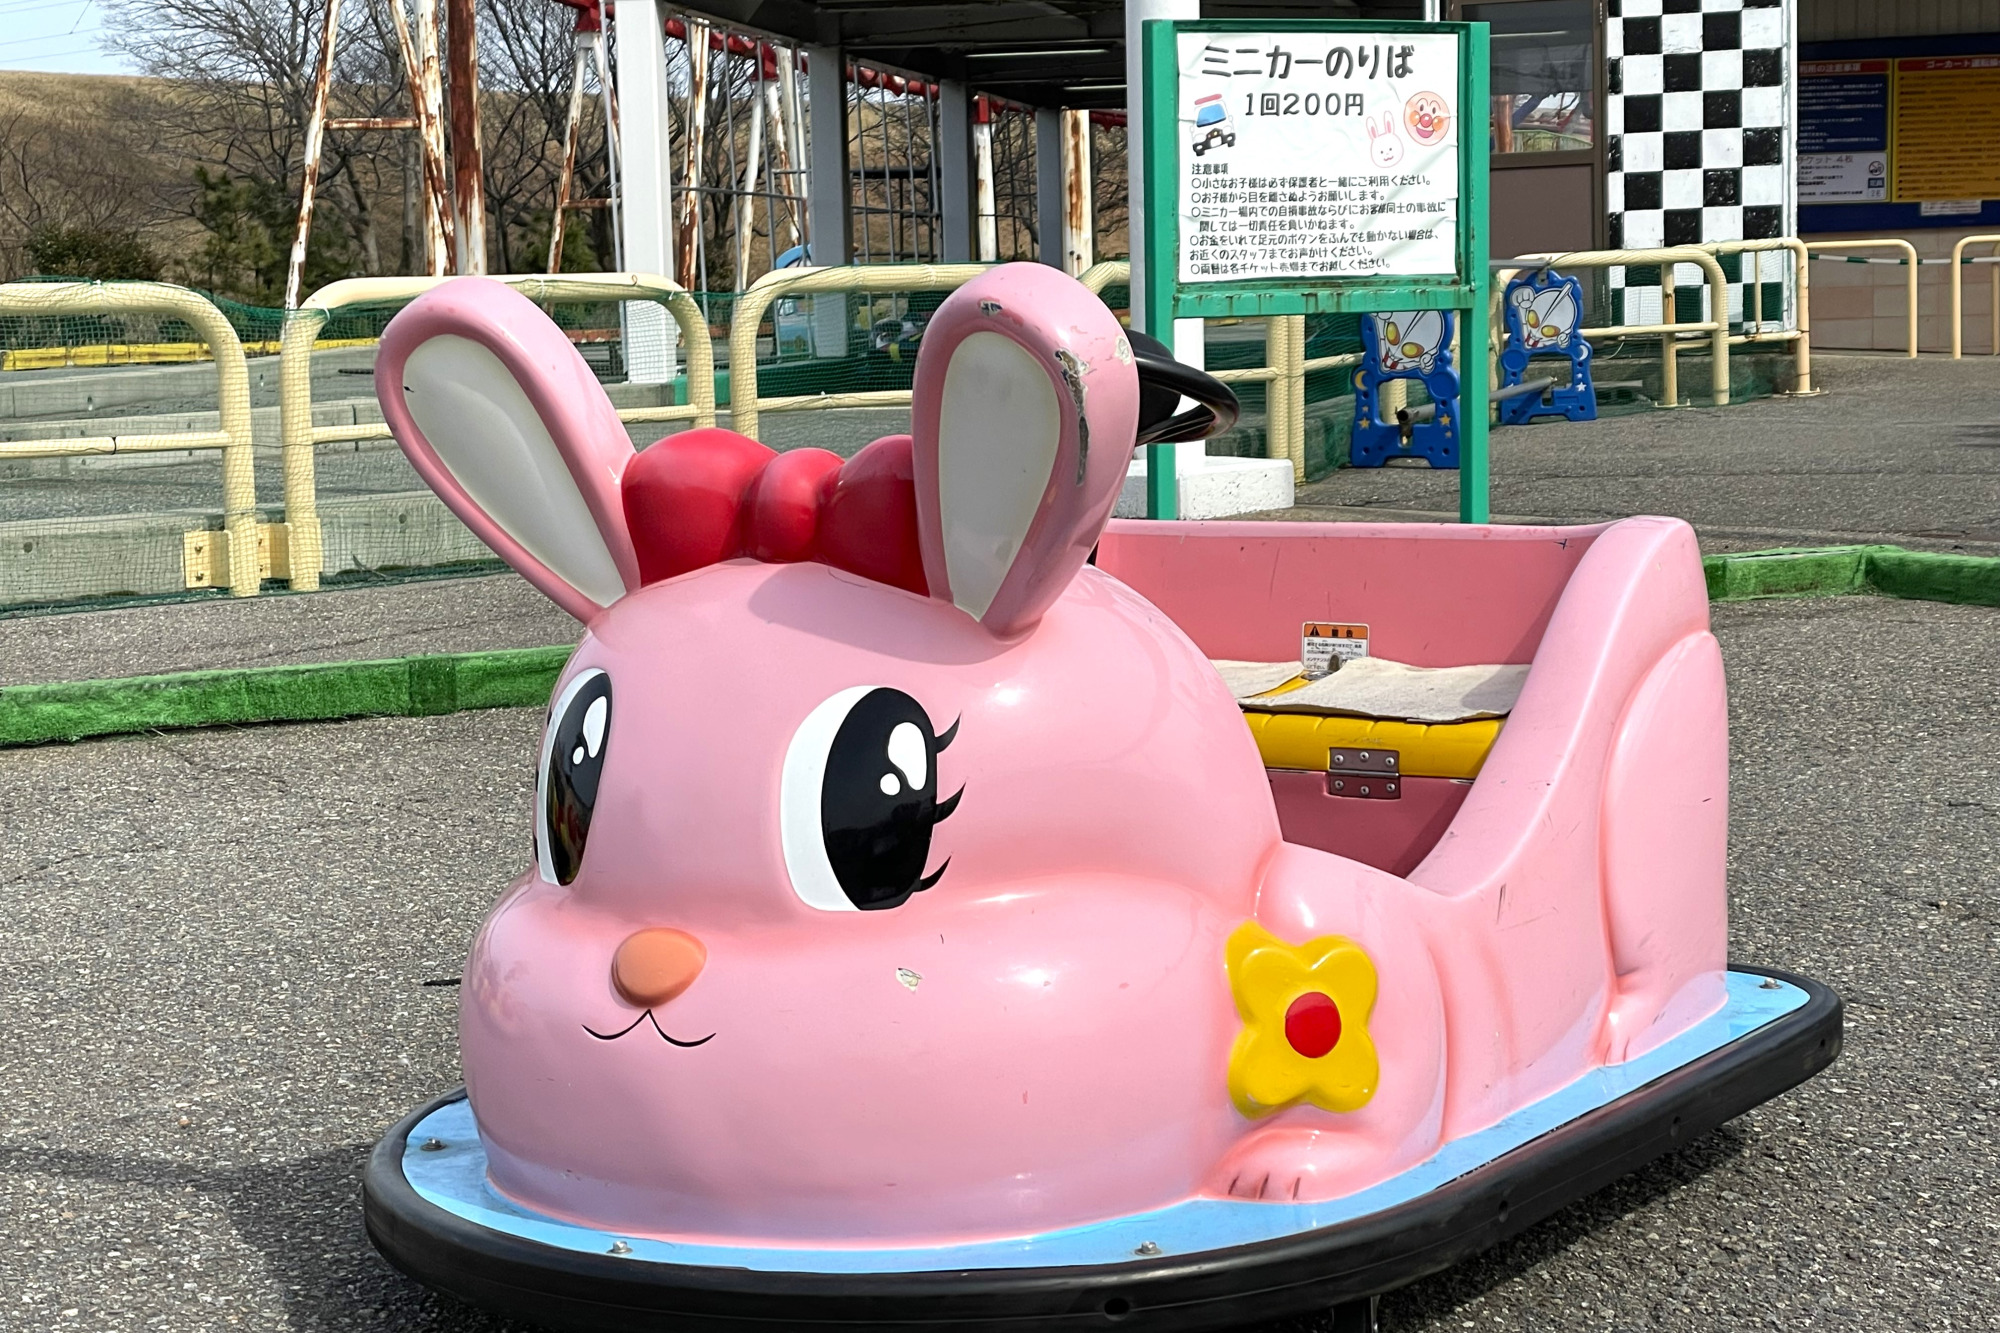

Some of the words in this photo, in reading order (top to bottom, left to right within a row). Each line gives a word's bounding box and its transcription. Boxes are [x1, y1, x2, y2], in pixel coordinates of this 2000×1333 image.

[1201, 44, 1416, 80] ミニカーのりば
[1244, 91, 1365, 118] 1回200円
